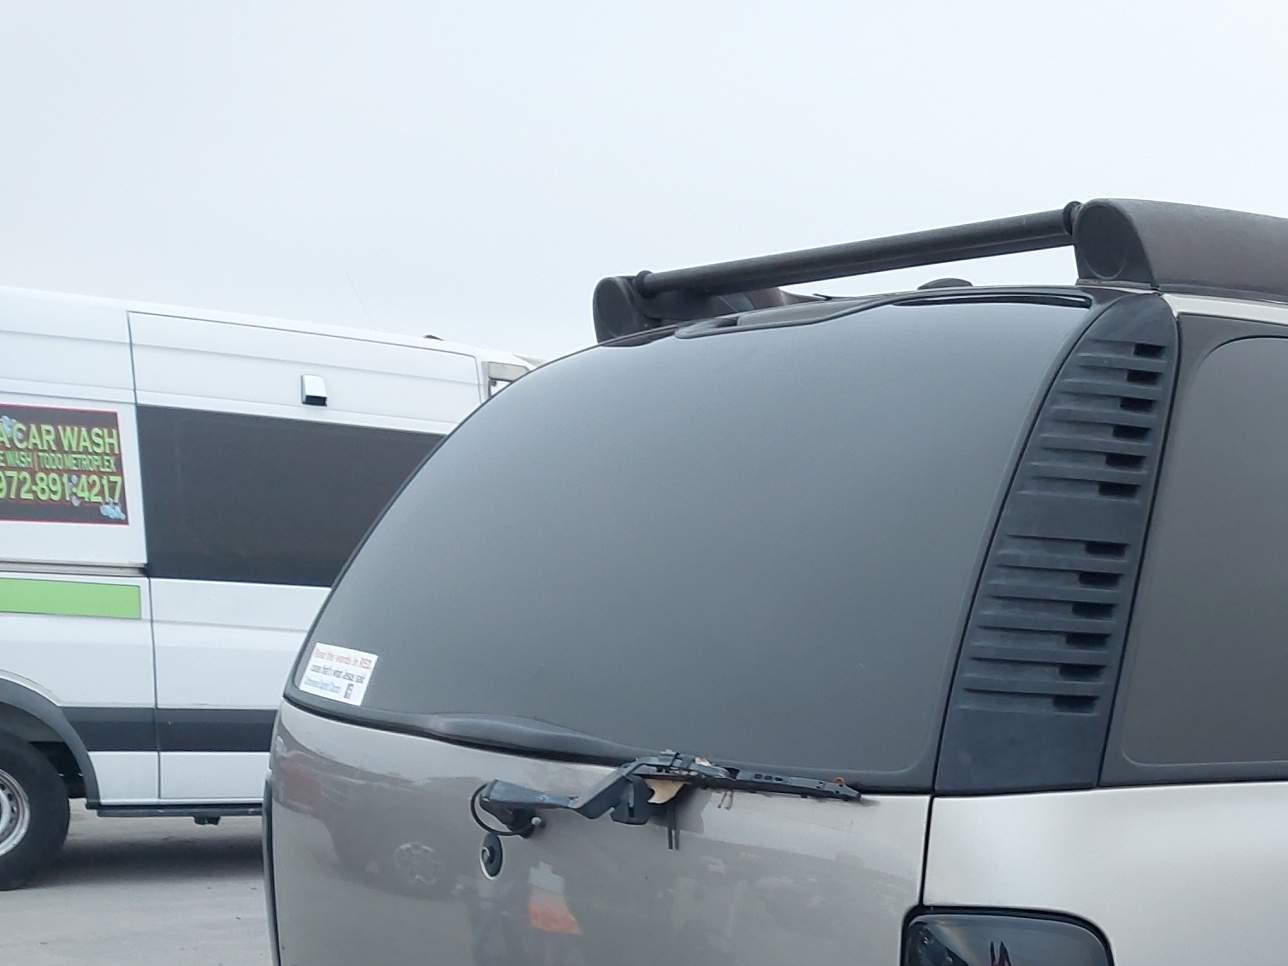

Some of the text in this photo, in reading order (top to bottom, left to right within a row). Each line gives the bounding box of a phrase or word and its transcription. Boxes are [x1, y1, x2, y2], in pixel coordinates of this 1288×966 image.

[12, 423, 56, 450] CAR
[58, 425, 119, 454] WASH
[63, 453, 116, 472] METROPLEX
